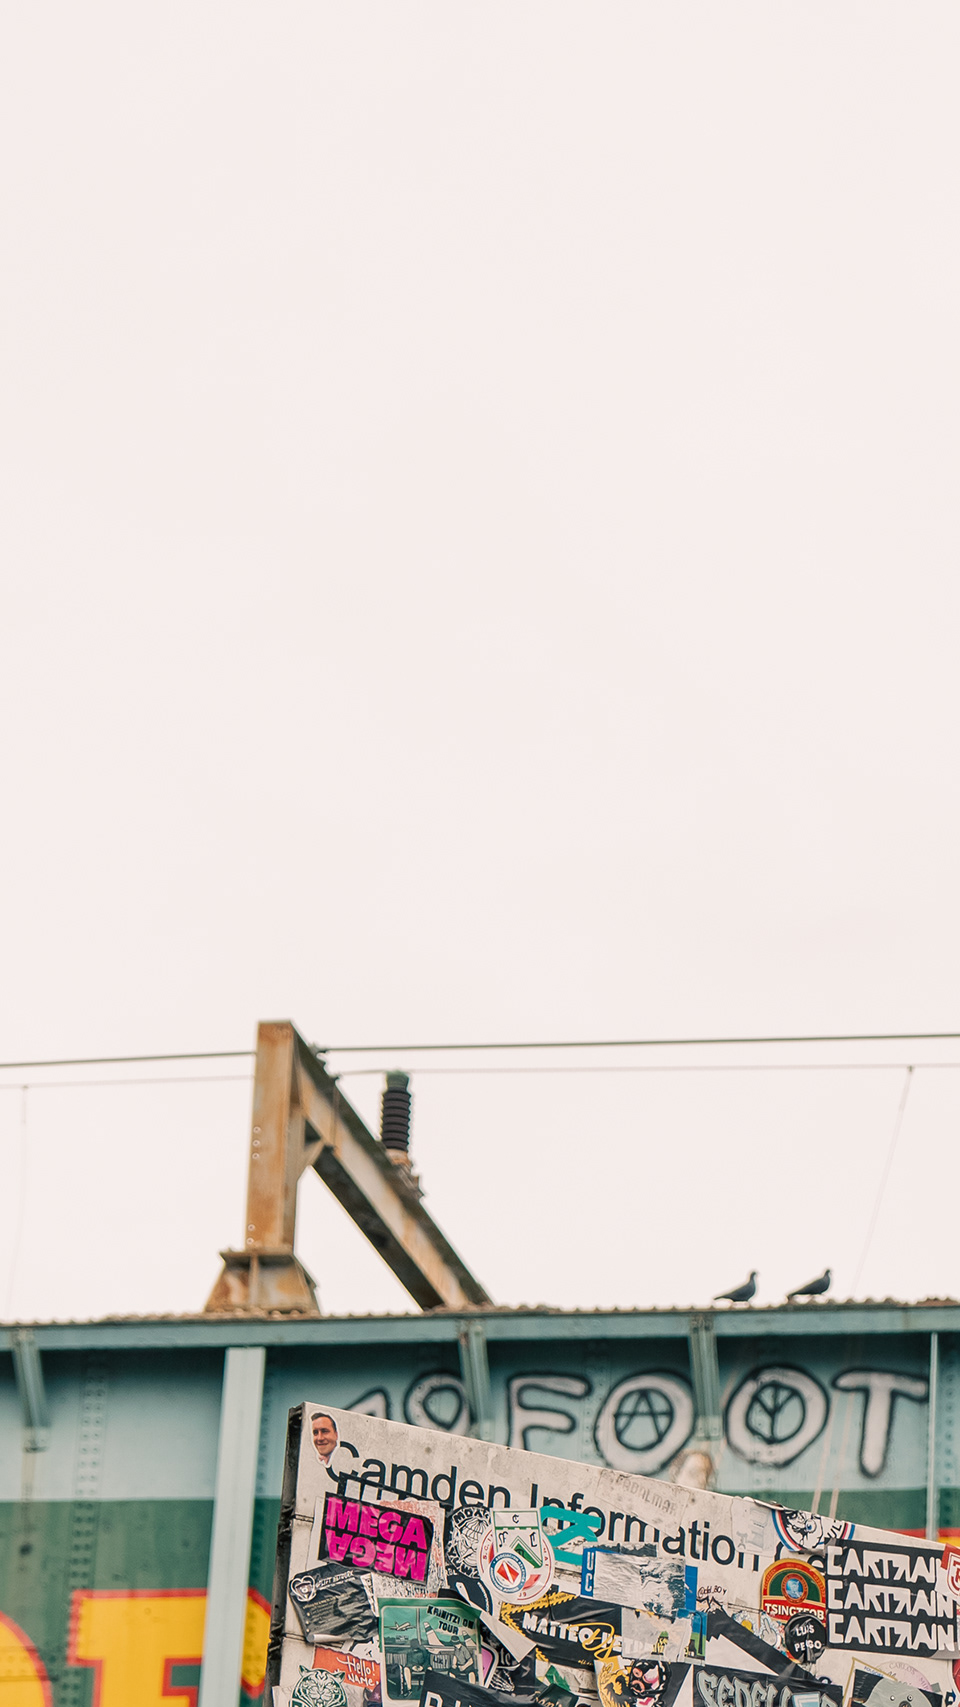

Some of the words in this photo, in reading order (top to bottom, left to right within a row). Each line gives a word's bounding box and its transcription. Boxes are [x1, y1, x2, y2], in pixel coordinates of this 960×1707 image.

[326, 1440, 512, 1510] Camden
[326, 1496, 427, 1550] MEGA
[324, 1528, 427, 1581] MEGA
[427, 1605, 460, 1624] KRINITZI
[462, 1618, 474, 1630] ON
[828, 1579, 954, 1619] CARTRAIN
[438, 1620, 460, 1636] TOUR
[522, 1612, 594, 1645] MATTEO
[829, 1612, 955, 1651] CARTRAIN
[336, 1655, 375, 1676] Hello!
